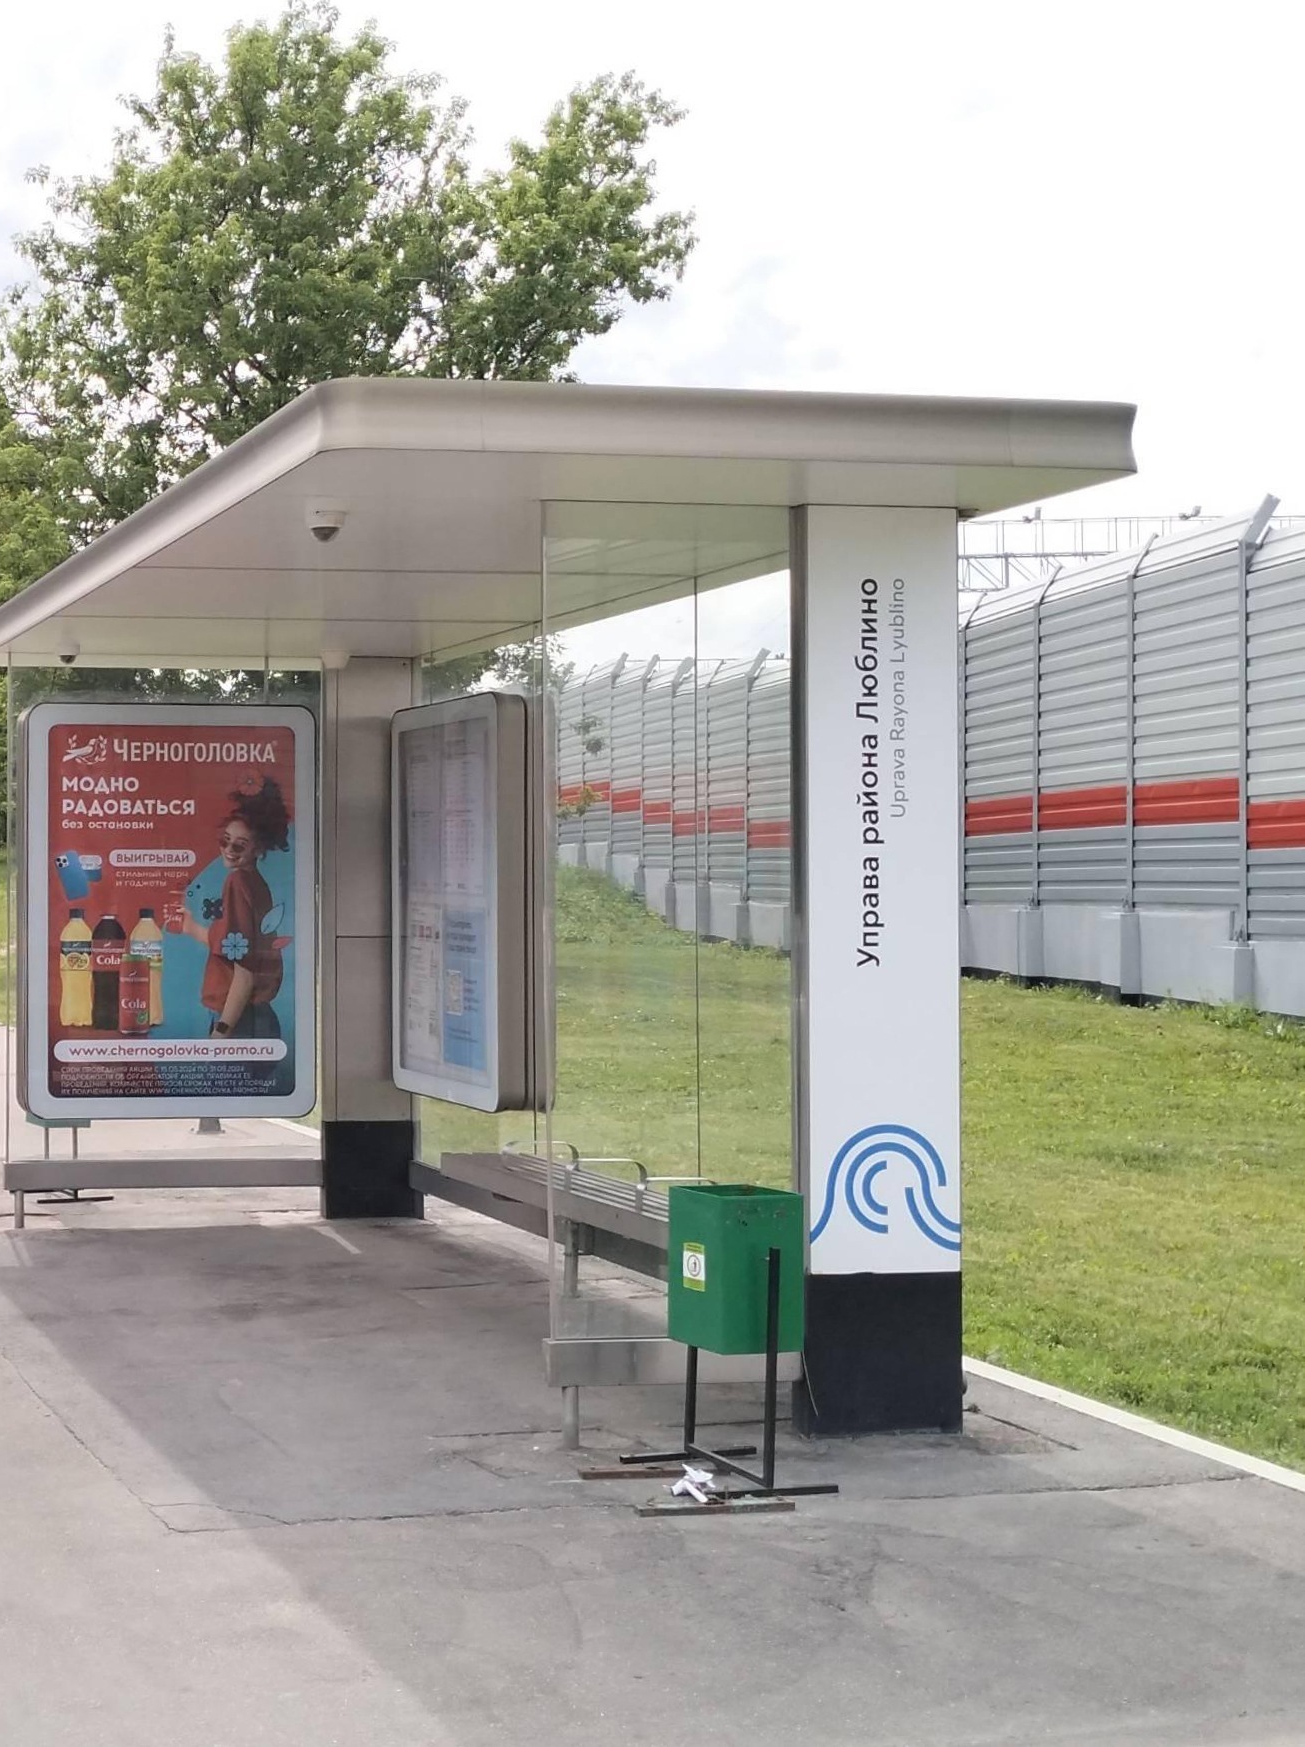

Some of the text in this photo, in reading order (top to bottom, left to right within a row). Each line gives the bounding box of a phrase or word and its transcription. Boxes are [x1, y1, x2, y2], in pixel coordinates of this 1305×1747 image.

[888, 578, 909, 818] Uprava Rayona Lyublino
[113, 738, 276, 763] ЧЕРНОГОЛОВКА
[854, 578, 885, 967] Управа района Люблино
[61, 776, 140, 795] МОДНО
[61, 799, 195, 817] РАДОВАТЬСЯ
[61, 819, 154, 829] без остановки
[116, 851, 190, 863] ВЫИГРЫВАЙ
[96, 954, 121, 965] Cola
[121, 998, 147, 1009] Cola
[69, 1044, 275, 1058] www.chernogolovka-promo.ru
